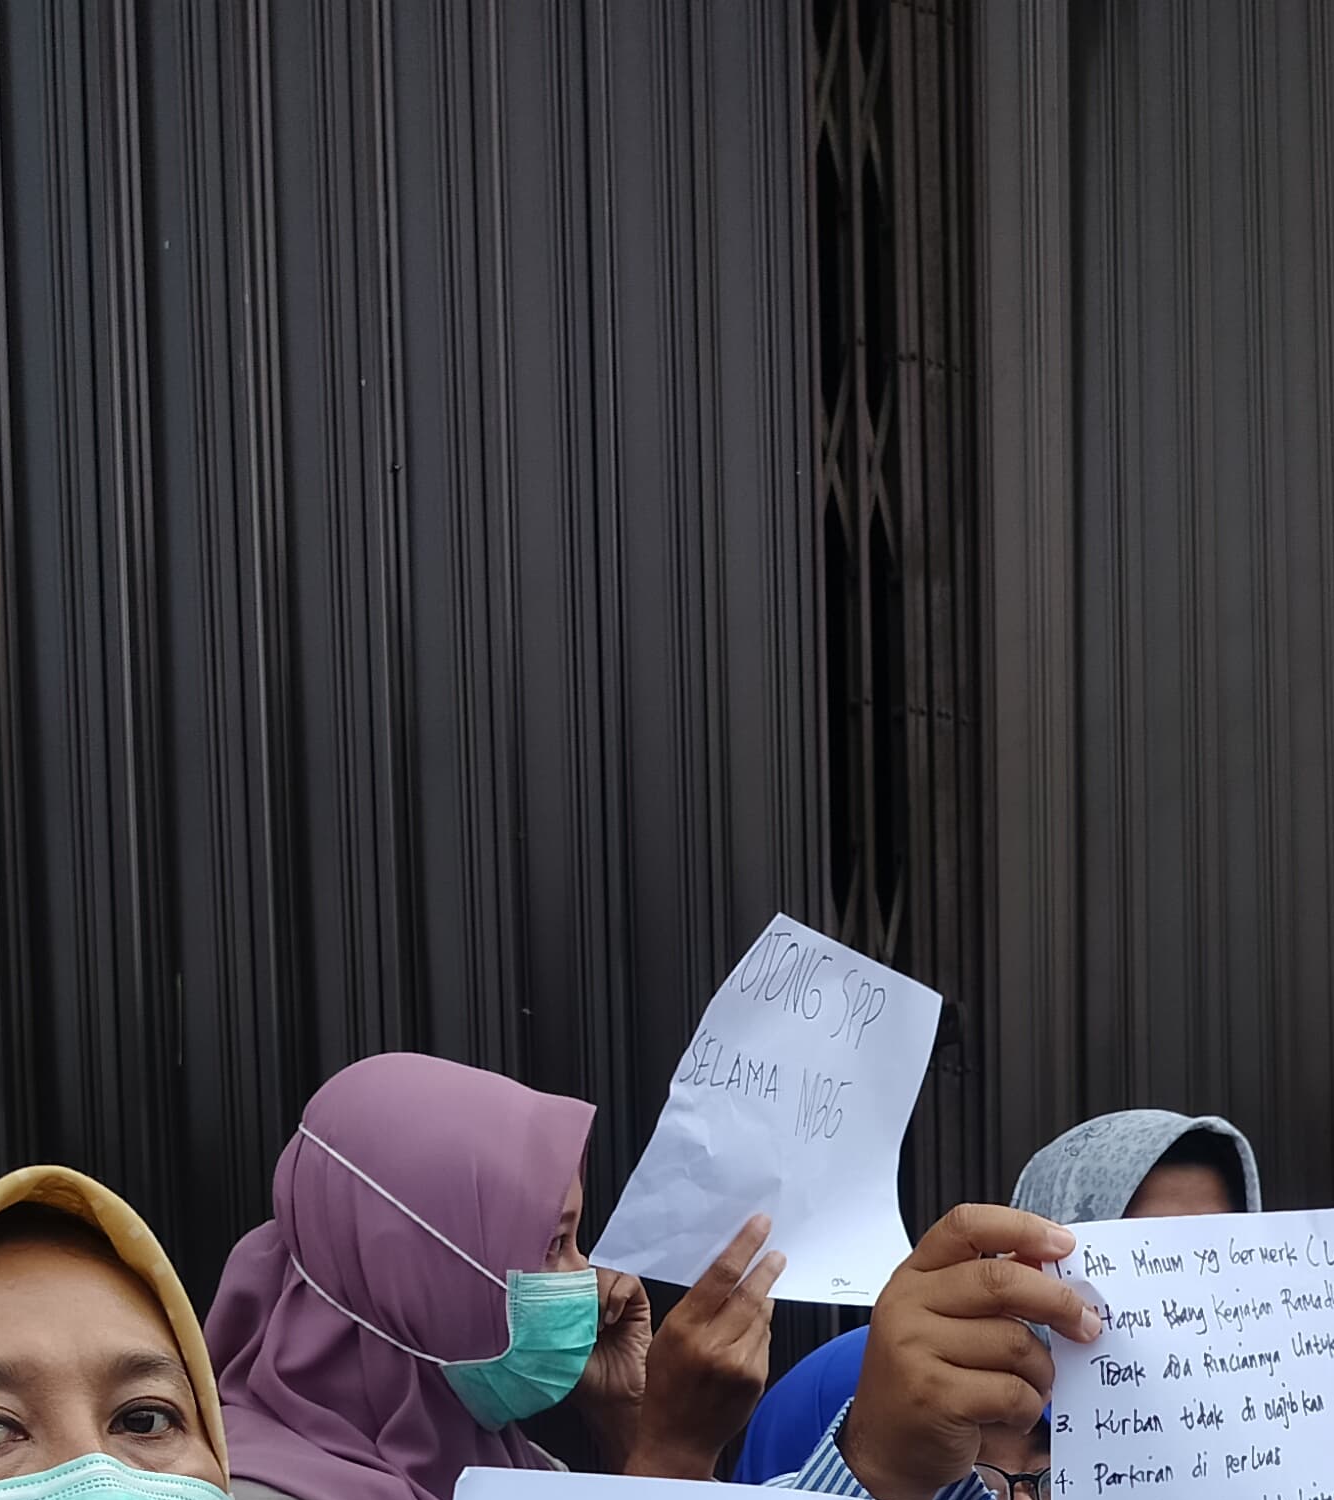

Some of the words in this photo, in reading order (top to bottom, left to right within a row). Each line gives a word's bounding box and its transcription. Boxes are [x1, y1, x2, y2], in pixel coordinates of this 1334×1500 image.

[729, 931, 833, 1020] OTONG
[830, 968, 886, 1050] SPP
[679, 1029, 780, 1104] SELAMA
[795, 1067, 853, 1144] MBG
[1192, 1451, 1208, 1478] di
